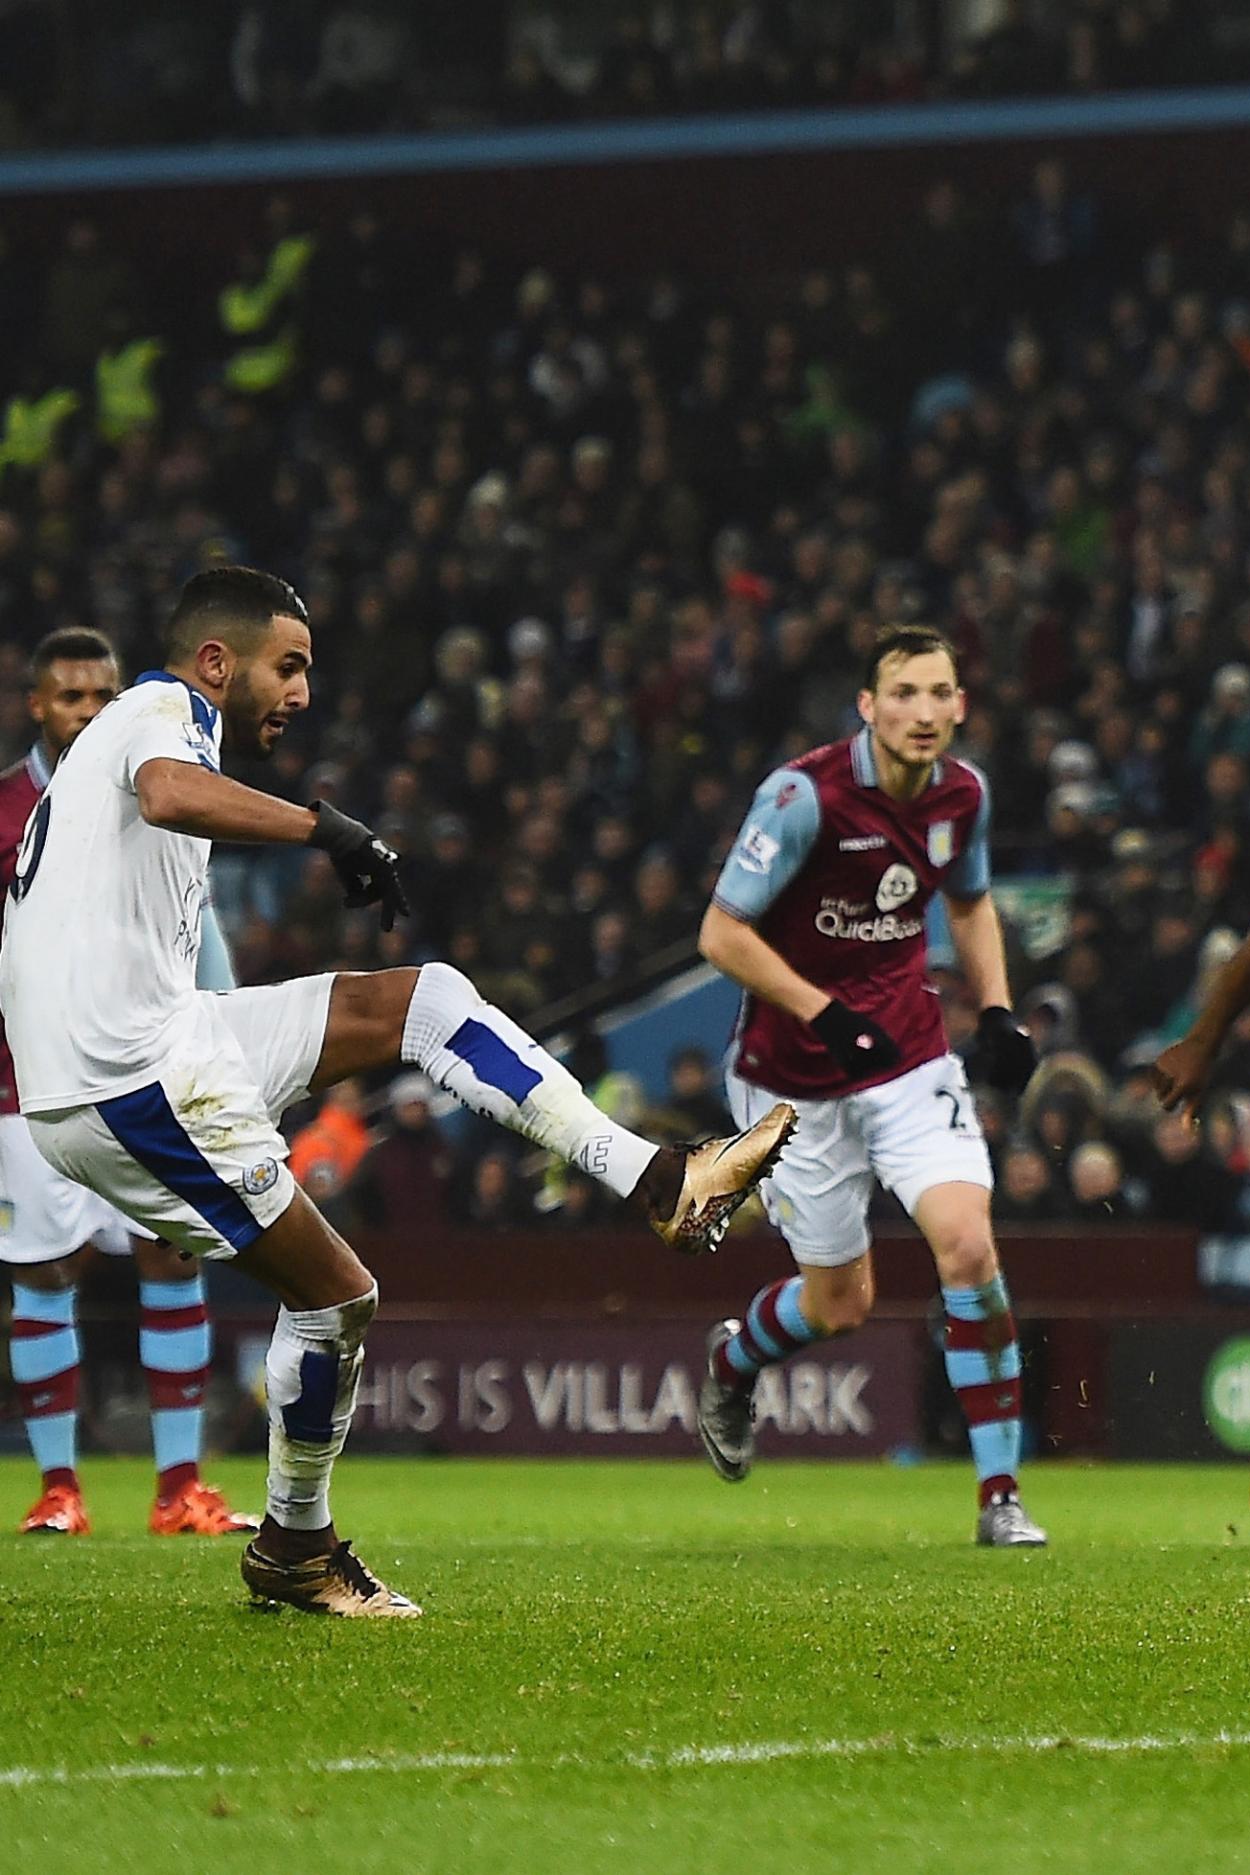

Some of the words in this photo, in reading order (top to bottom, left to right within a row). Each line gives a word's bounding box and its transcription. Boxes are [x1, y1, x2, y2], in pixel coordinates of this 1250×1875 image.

[351, 1361, 444, 1433] HIS
[458, 1361, 512, 1433] IS
[522, 1363, 698, 1434] VILLA
[750, 1362, 874, 1435] ARK
